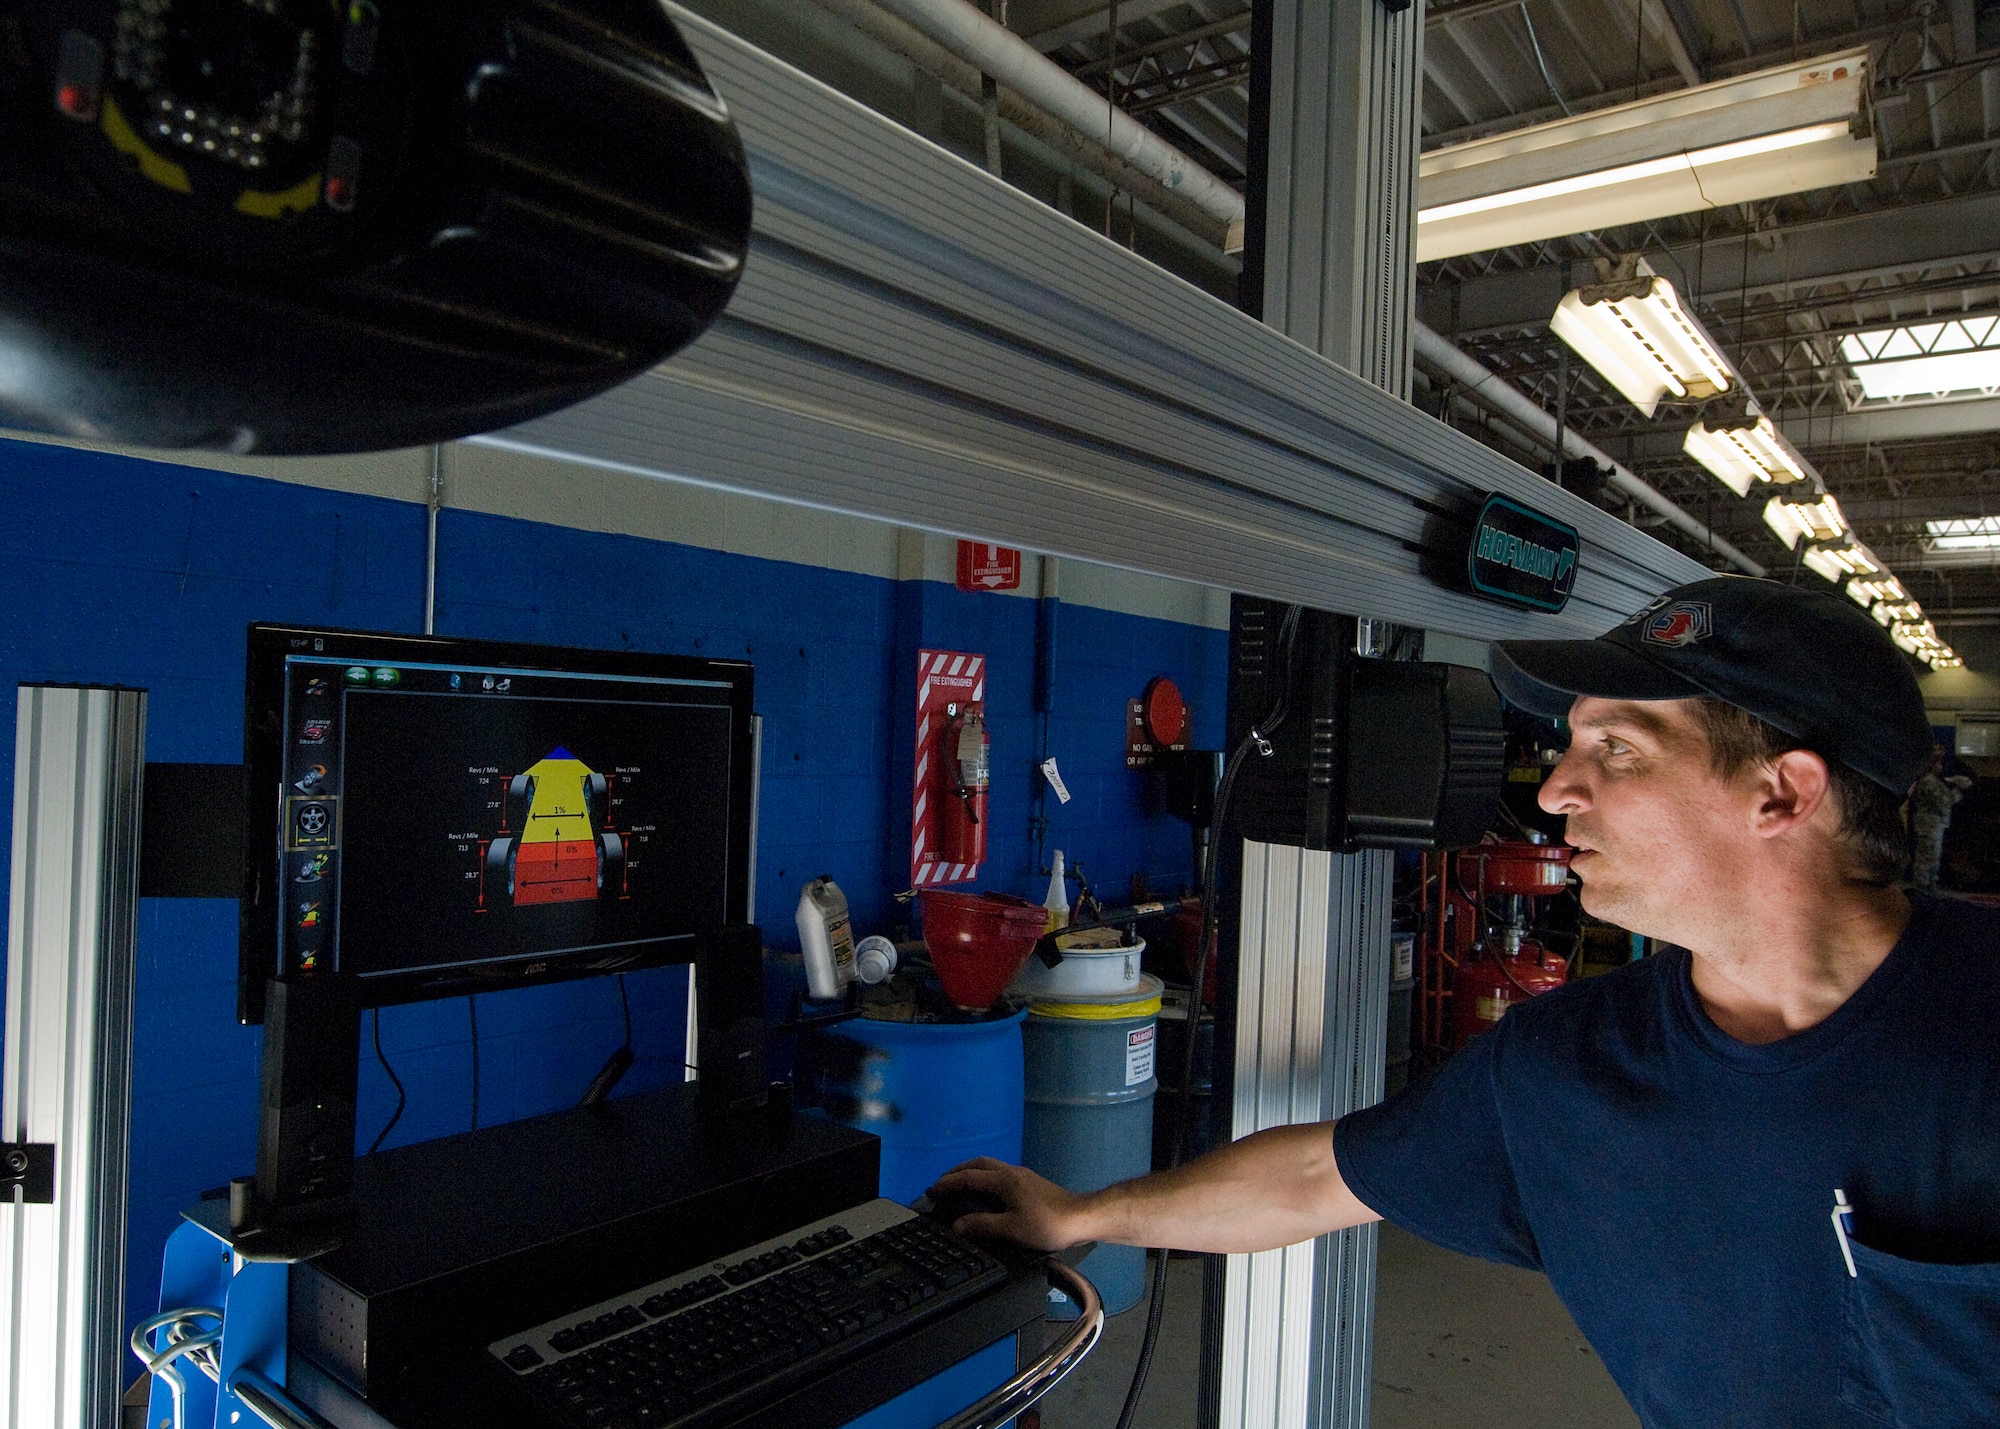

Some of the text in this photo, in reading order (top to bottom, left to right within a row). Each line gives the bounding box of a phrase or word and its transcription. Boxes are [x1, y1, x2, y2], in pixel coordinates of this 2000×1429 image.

[1477, 525, 1556, 580] HOFMANN
[974, 567, 1011, 575] EXTINGUISHER
[930, 675, 972, 687] FIRE EXTINGUISHER
[1127, 756, 1136, 765] OR
[486, 766, 499, 774] Mile
[554, 806, 566, 814] 1%
[457, 844, 469, 852] 713
